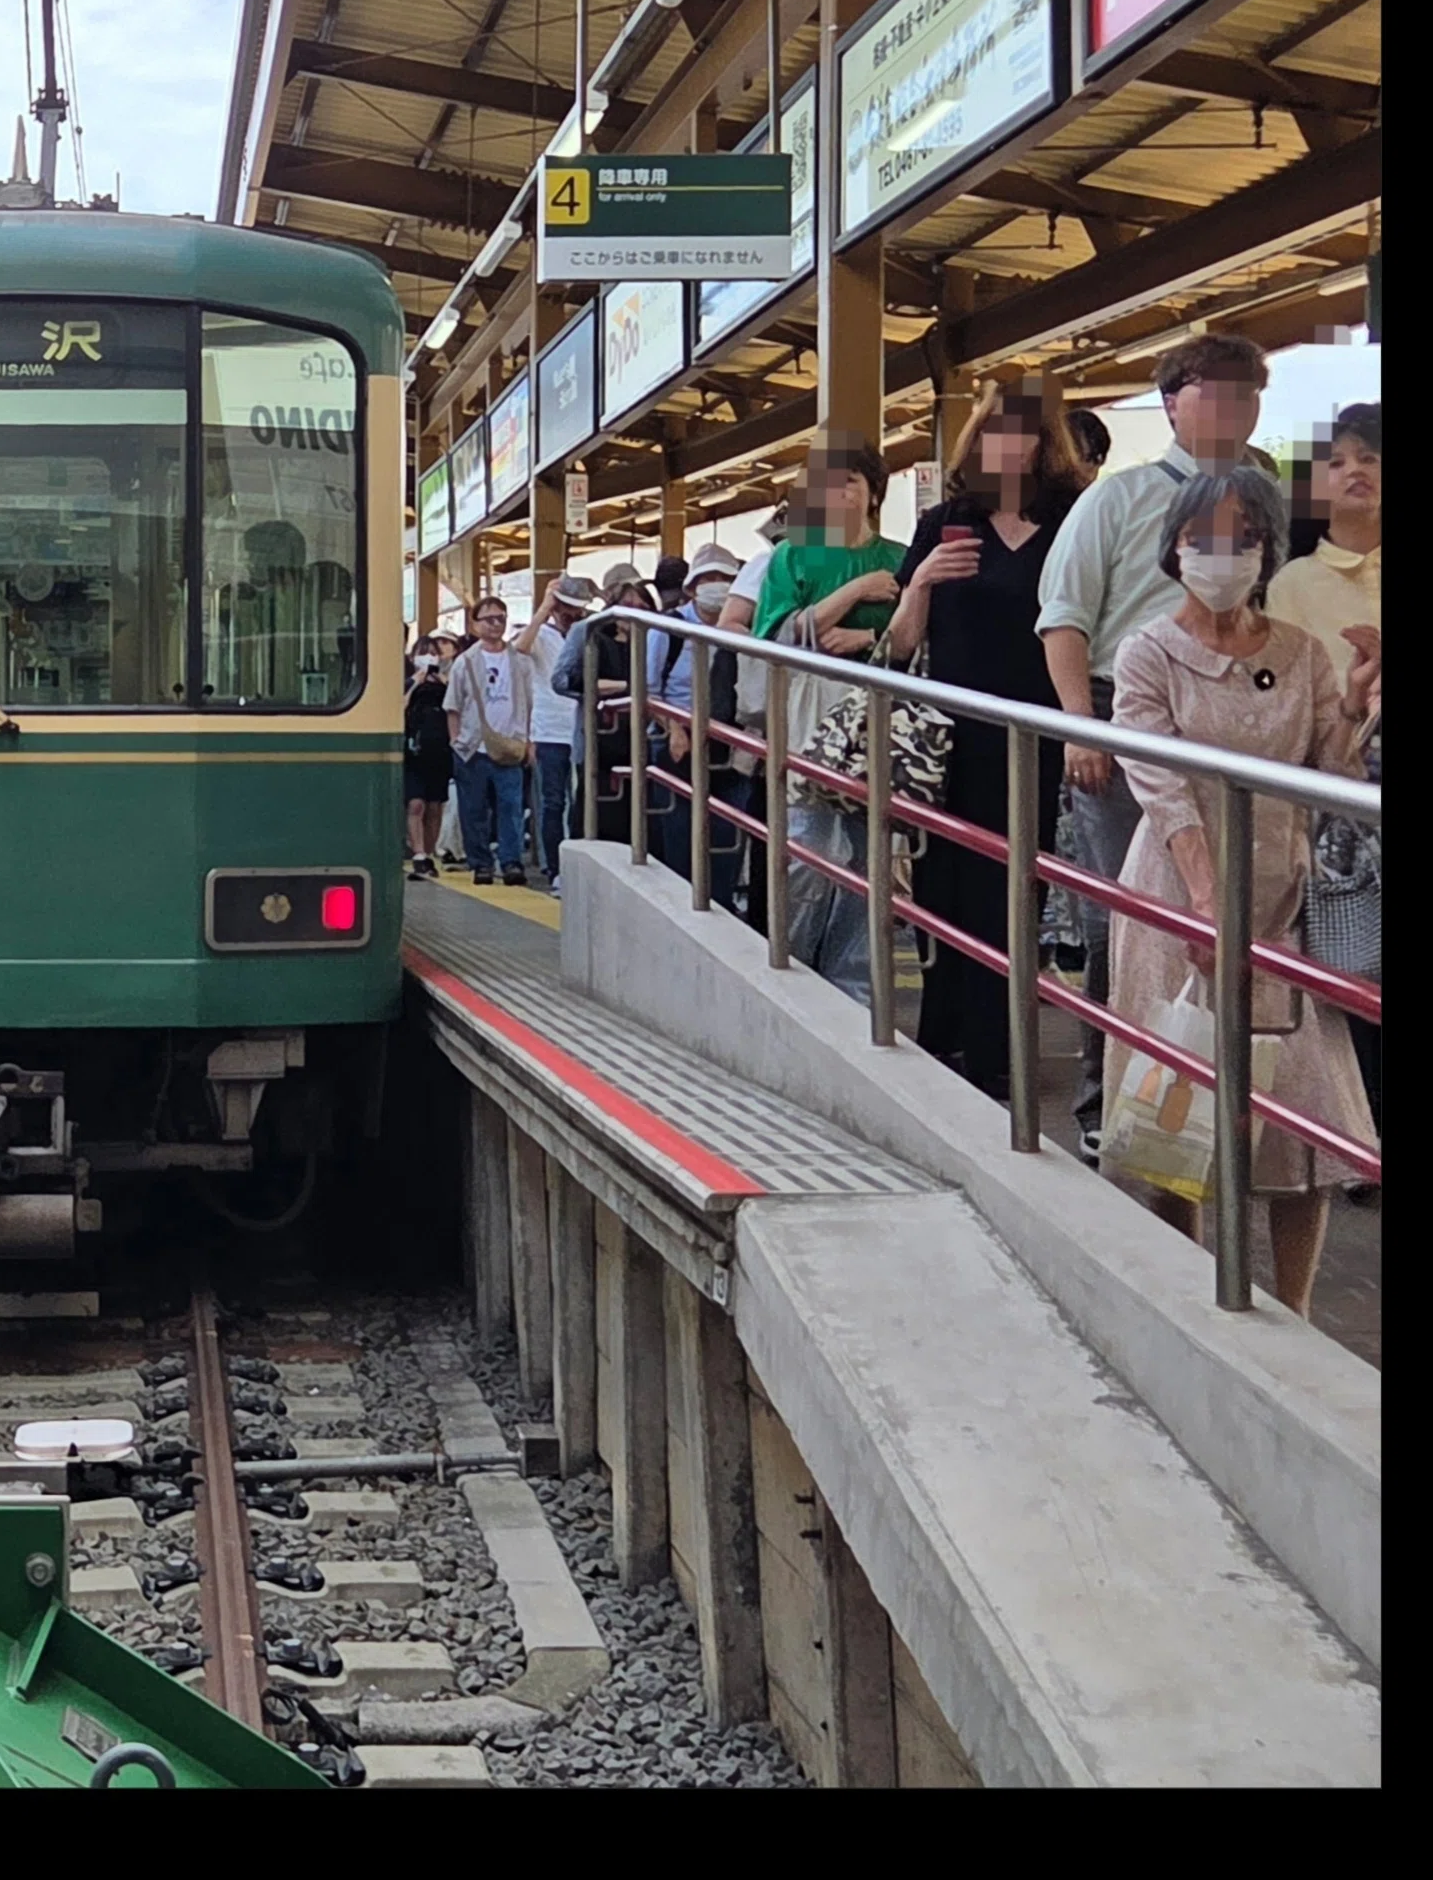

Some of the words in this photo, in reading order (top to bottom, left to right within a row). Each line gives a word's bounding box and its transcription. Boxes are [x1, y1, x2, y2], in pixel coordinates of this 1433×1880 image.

[598, 168, 668, 186] 降車専用
[550, 176, 582, 217] 4
[645, 191, 667, 203] only
[569, 250, 764, 266] ここからはご乗車になれません
